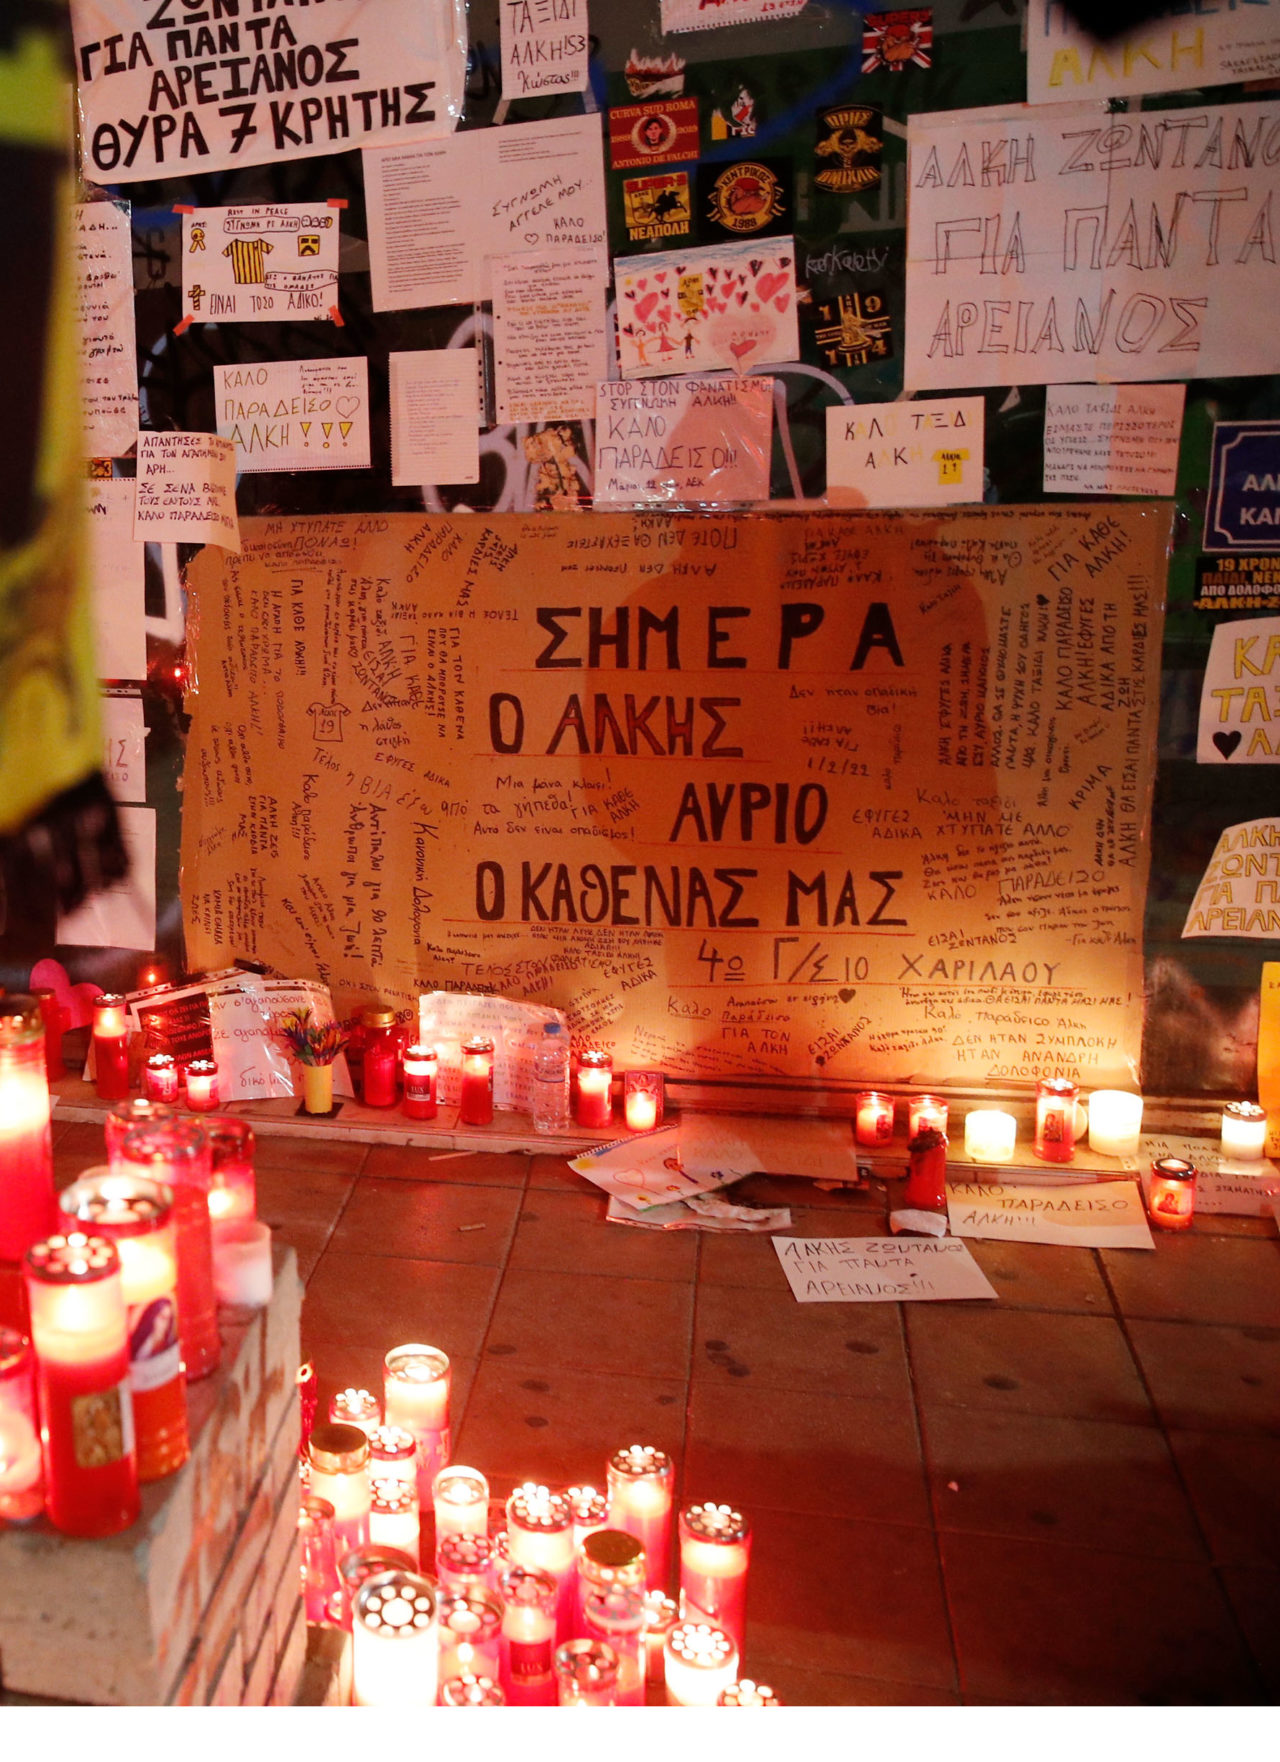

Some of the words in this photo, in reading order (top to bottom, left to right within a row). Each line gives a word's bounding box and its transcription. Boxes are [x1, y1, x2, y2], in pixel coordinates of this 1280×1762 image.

[80, 32, 154, 82] ΓΙΑ
[166, 14, 297, 62] ΠΑΝΤΑ
[148, 38, 360, 112] ΑΡΕΙΑΝΟΣ
[610, 105, 642, 120] CURVA
[643, 102, 664, 115] SUD
[666, 99, 696, 112] ROMA
[92, 111, 210, 171] ΘΥΡΑ
[219, 102, 258, 154] 7
[269, 81, 436, 150] ΚΡΗΤΗΣ
[612, 157, 651, 170] ANTONIO
[653, 155, 666, 165] DE
[916, 132, 1036, 188] ΑΛΚΗ
[553, 216, 585, 231] ΚΑΛΟ
[629, 220, 689, 241] ΝΕΑΠΟΛΗ
[934, 217, 1028, 275] ΓΙΑ
[1064, 187, 1278, 273] ΠΑΝΤΑ
[927, 288, 1208, 359] ΑΡΕΙΑΝΟΣ
[222, 368, 269, 390] ΚΑΛΟ
[600, 382, 632, 398] STOP
[640, 380, 680, 397] ΣΤΟΝ
[224, 396, 332, 421] ΠΑΡΑΔΕΙΣΟ
[230, 422, 290, 453] ΑΛΚΗ
[608, 415, 666, 441] ΚΑΛΟ
[1242, 474, 1280, 492] ΑΛ
[1240, 507, 1280, 525] ΚΑ
[692, 528, 738, 550] ΠΟΤΕ
[1217, 559, 1235, 571] 19
[1201, 585, 1226, 596] ΑΠΟ
[449, 627, 460, 648] ΓΙΑ
[535, 602, 905, 671] ΣΗΜΕΡΑ
[1100, 625, 1116, 656] ΑΠΟ
[453, 655, 465, 684] ΤΟΝ
[1056, 666, 1073, 711] ΚΑΛΟ
[1100, 662, 1114, 712] ΑΔΙΚΑ
[489, 693, 525, 754] Ο
[545, 693, 744, 758] ΑΛΚΗΣ
[1070, 764, 1112, 811] ΚΡΙΜΑ
[669, 782, 828, 845] ΑΥΡΙΟ
[872, 827, 922, 839] ΑΔΙΚΑ
[476, 861, 505, 921] Ο
[522, 861, 759, 927] ΚΑΘΕΝΑΣ
[786, 869, 907, 926] ΜΑΣ
[927, 885, 977, 901] ΚΑΛΟ
[898, 954, 1061, 985] ΧΑΡΙΛΑΟΥ
[721, 1028, 748, 1040] ΓΙΑ
[761, 1029, 790, 1041] ΤΟΝ
[952, 1034, 982, 1047] ΔΕΝ
[989, 1033, 1027, 1044] ΗΤΑΝ
[748, 1041, 788, 1055] ΑΛΚΗ
[957, 1048, 1000, 1062] ΗΤΑΝ
[1022, 1049, 1099, 1064] ΑΝΑΝΔΡΗ
[987, 1064, 1081, 1079] ΔΟΛΟΦΟΝΙΑ
[1001, 1197, 1129, 1212] ΠΑΡΑΔΕΙΣΟ
[785, 1240, 853, 1260] ΑΛΚΗΣ
[794, 1258, 827, 1273] ΓΙΑ
